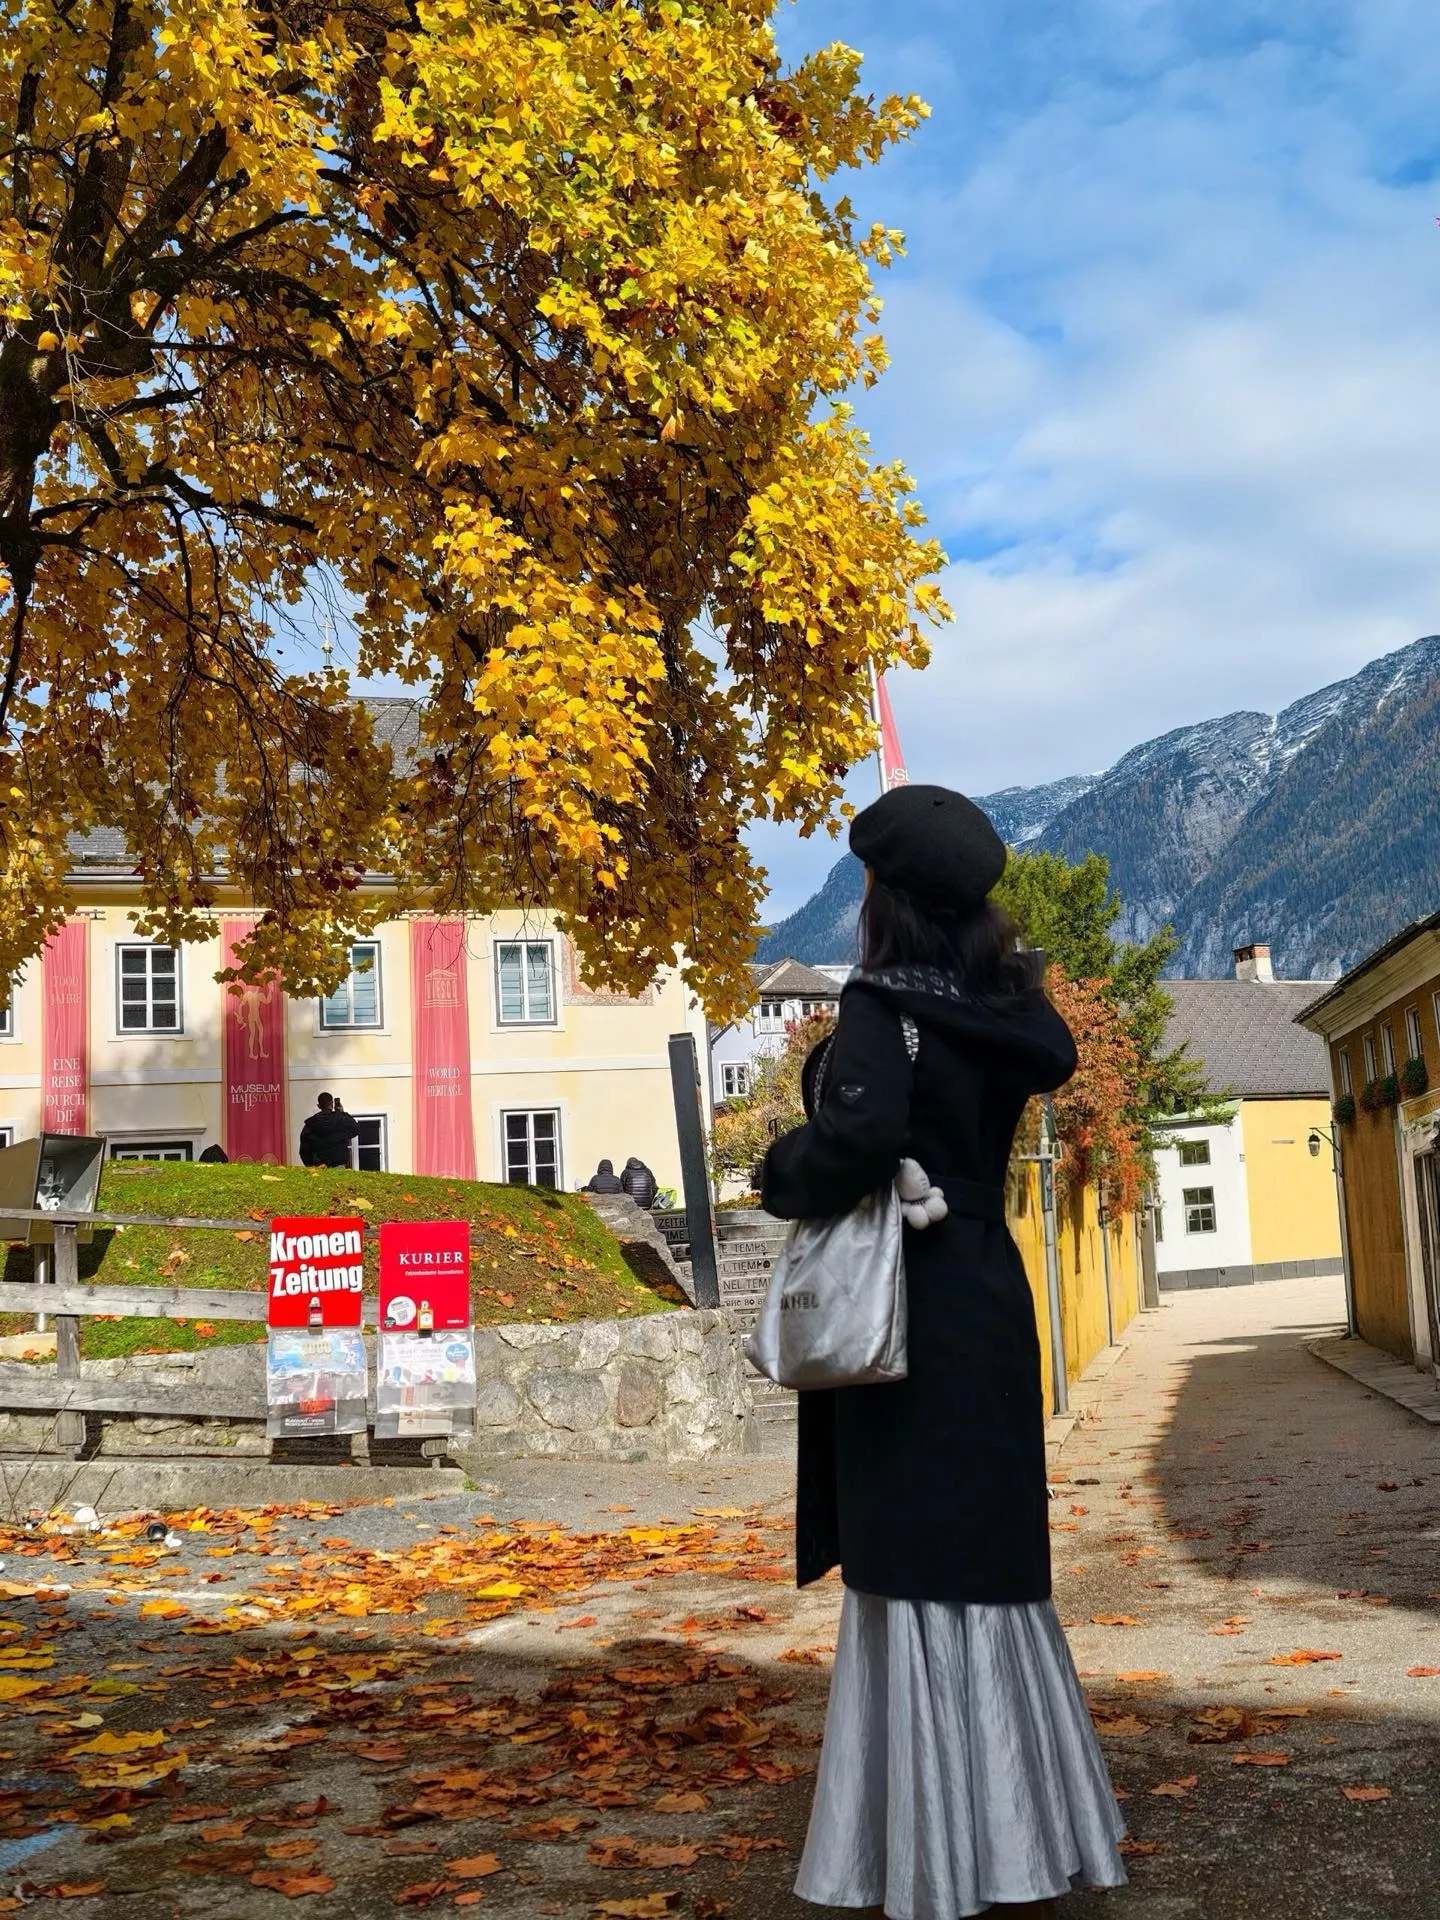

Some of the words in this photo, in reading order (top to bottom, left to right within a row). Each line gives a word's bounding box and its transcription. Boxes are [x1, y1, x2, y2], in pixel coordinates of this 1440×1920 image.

[53, 1057, 80, 1071] EINE
[429, 1067, 461, 1079] WORLD
[51, 1075, 81, 1088] REISE
[230, 1083, 281, 1094] MUSEUM
[427, 1084, 464, 1097] HERITAGE
[45, 1093, 85, 1107] DURCH
[231, 1093, 280, 1112] HALLSTATT
[56, 1109, 77, 1123] DIE
[269, 1230, 362, 1263] Kronen
[735, 1242, 767, 1254] TEMPS
[399, 1251, 464, 1265] KURIER
[732, 1260, 771, 1273] TIEMPO
[271, 1263, 363, 1298] Zeitung
[723, 1280, 741, 1290] NEL
[747, 1278, 770, 1289] TEM
